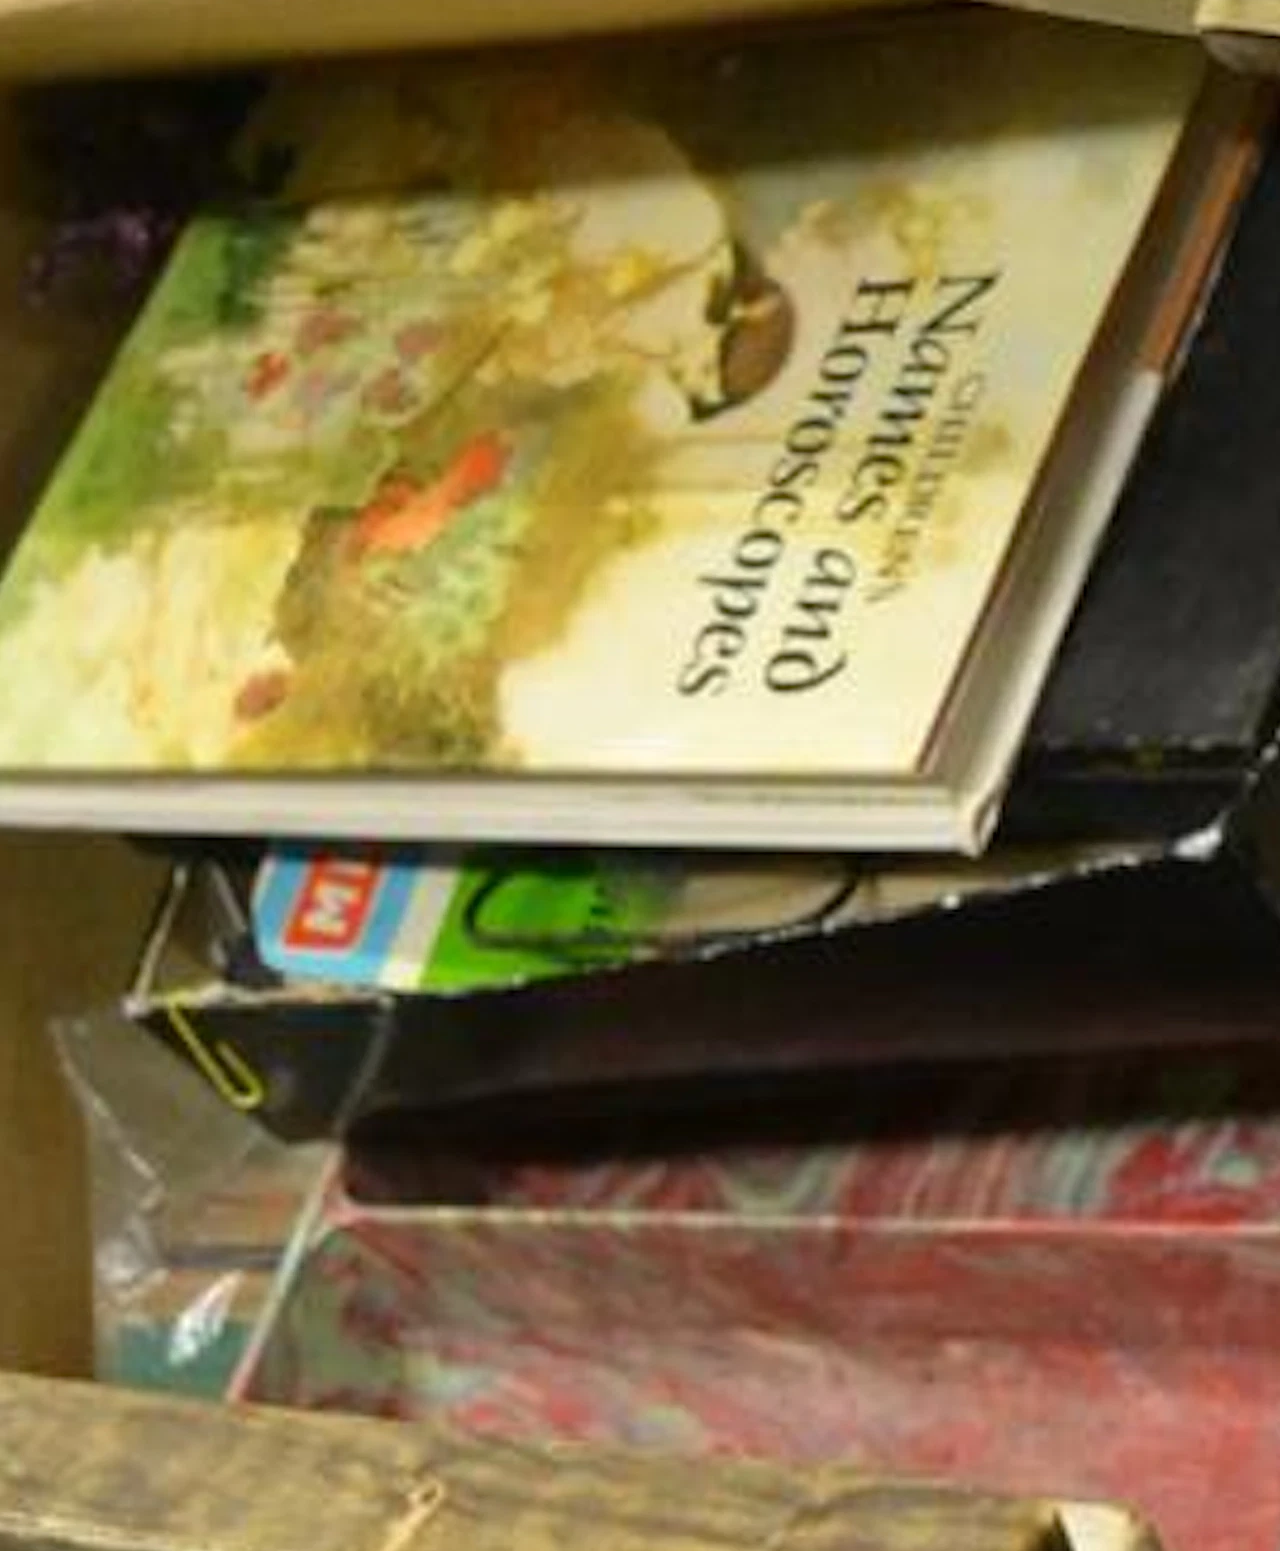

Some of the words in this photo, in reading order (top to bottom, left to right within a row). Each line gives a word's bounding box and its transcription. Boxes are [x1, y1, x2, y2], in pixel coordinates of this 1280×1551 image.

[676, 278, 917, 698] Horoscopes
[834, 269, 1004, 525] Names
[762, 548, 857, 696] and
